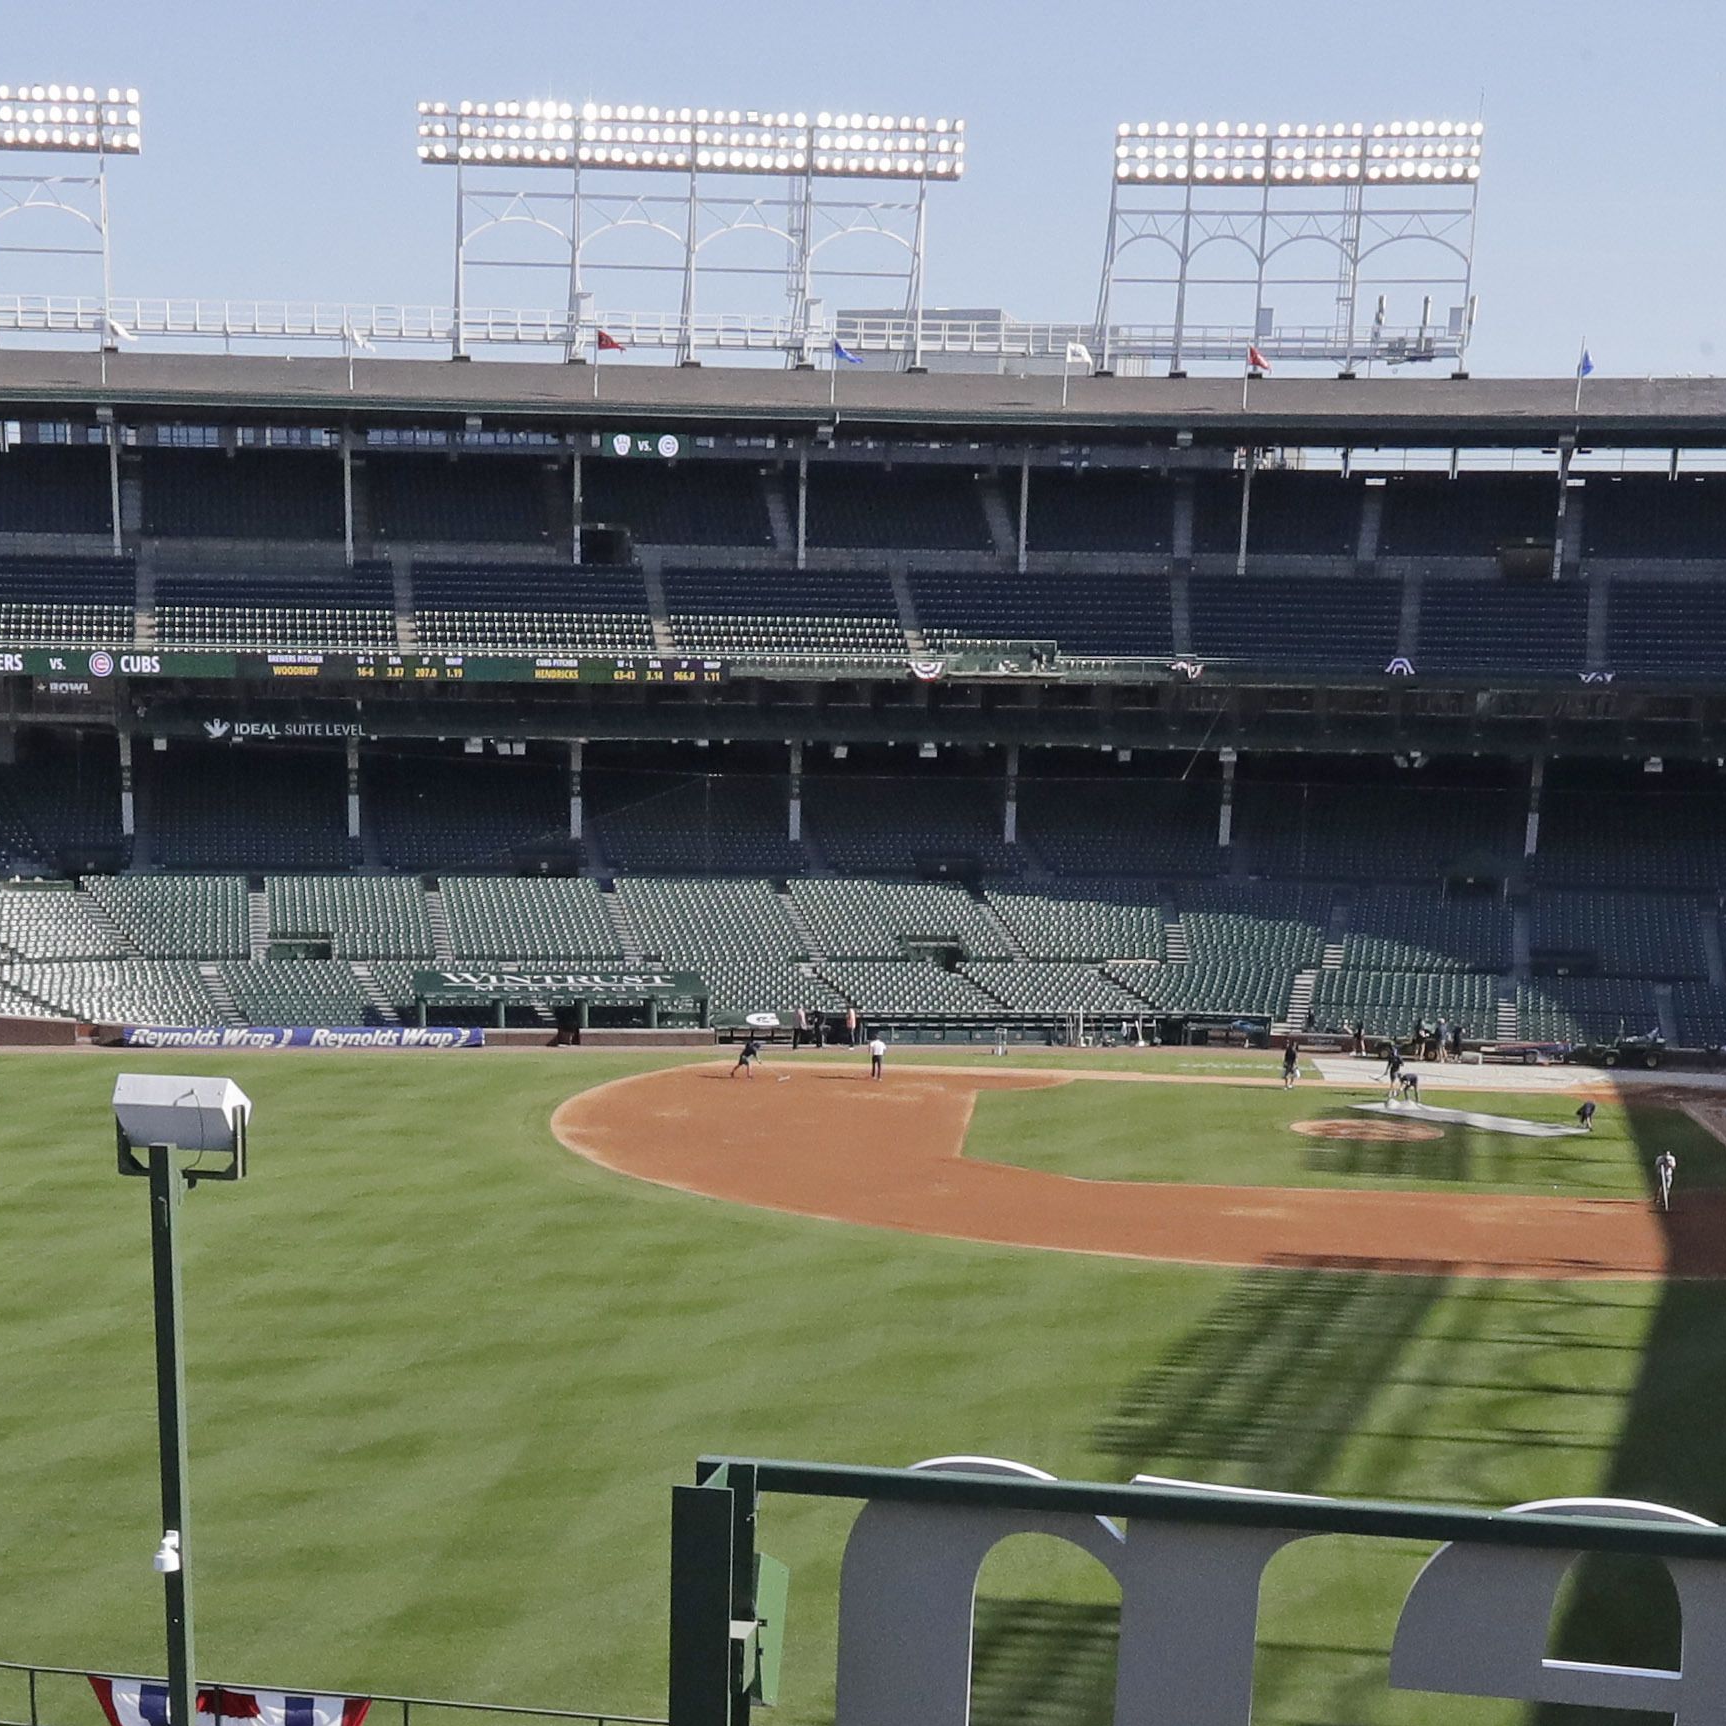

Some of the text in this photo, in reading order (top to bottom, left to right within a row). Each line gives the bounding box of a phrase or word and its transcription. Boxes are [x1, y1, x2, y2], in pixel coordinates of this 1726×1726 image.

[120, 655, 161, 673] CUBS
[273, 665, 319, 676] WOODRUFF
[534, 669, 579, 680] HENDRICKS
[49, 682, 92, 695] BOWL
[234, 723, 367, 737] IDEAL SUITE LEVEL
[440, 972, 675, 984] WINTRUST
[129, 1028, 275, 1048] Reynolds Wrap
[309, 1028, 455, 1048] Reynolds Wrap
